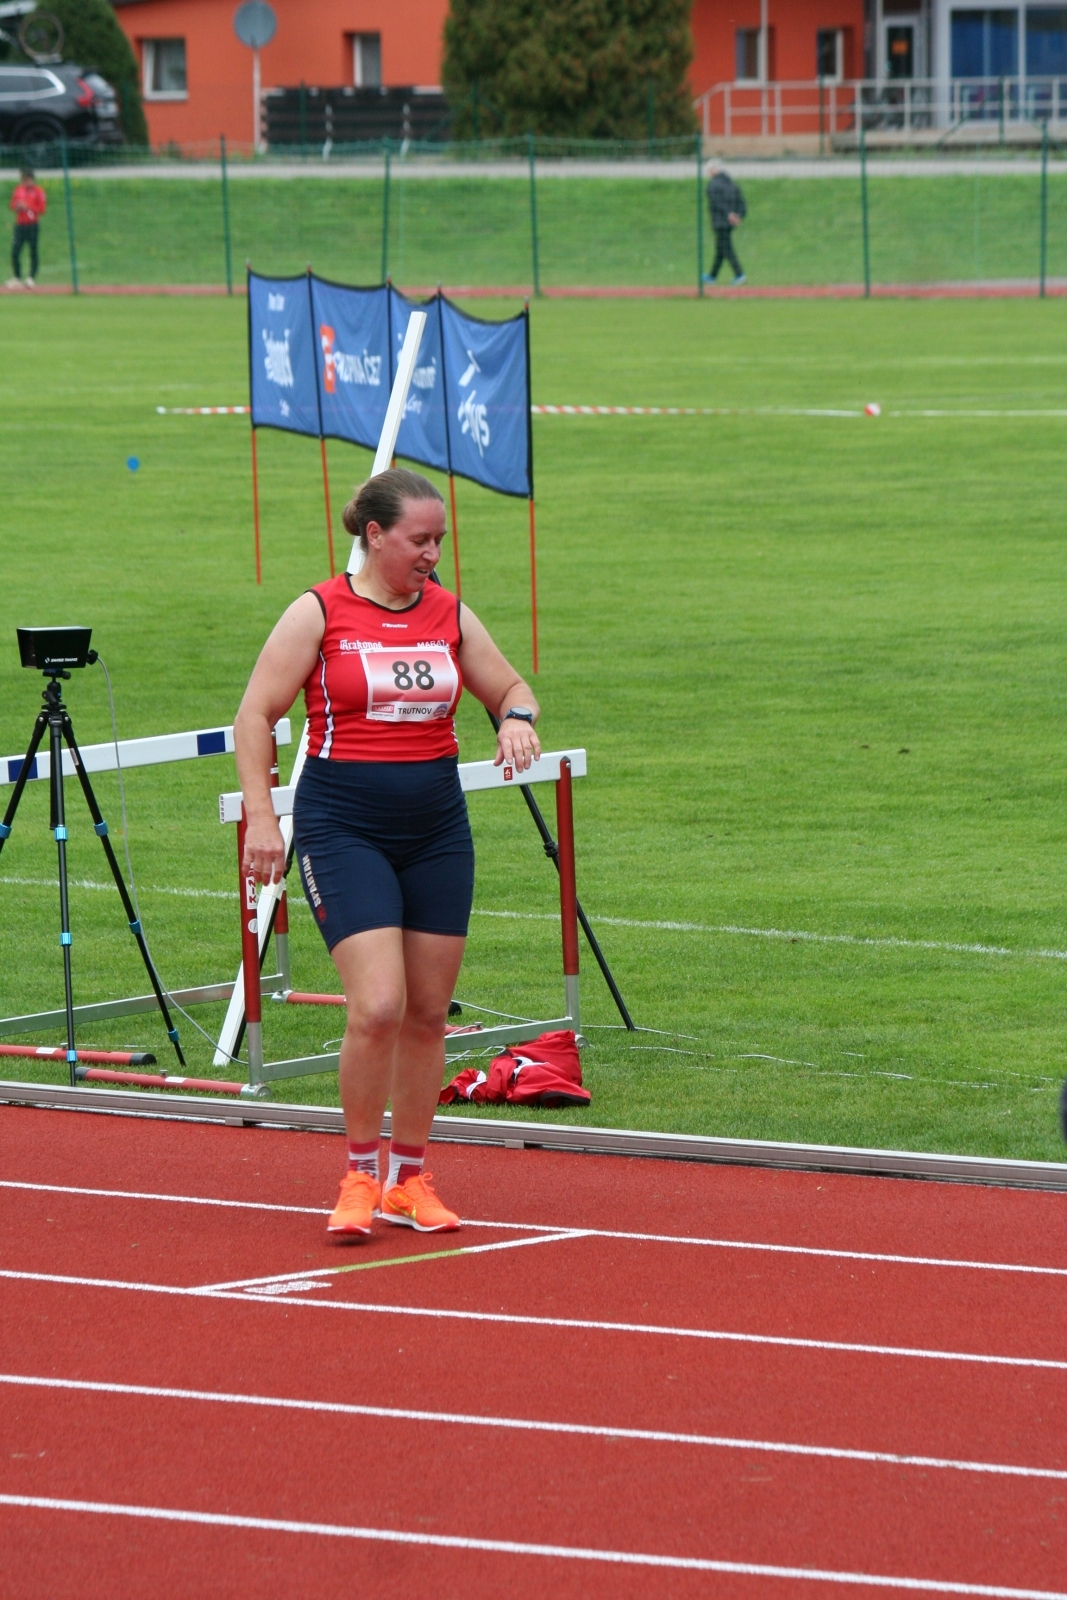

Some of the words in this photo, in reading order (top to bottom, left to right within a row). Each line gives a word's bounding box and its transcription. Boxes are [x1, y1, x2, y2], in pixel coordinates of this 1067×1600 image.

[392, 660, 435, 690] 88
[398, 707, 432, 715] TRUTNOV
[302, 854, 322, 908] SPARTAN
